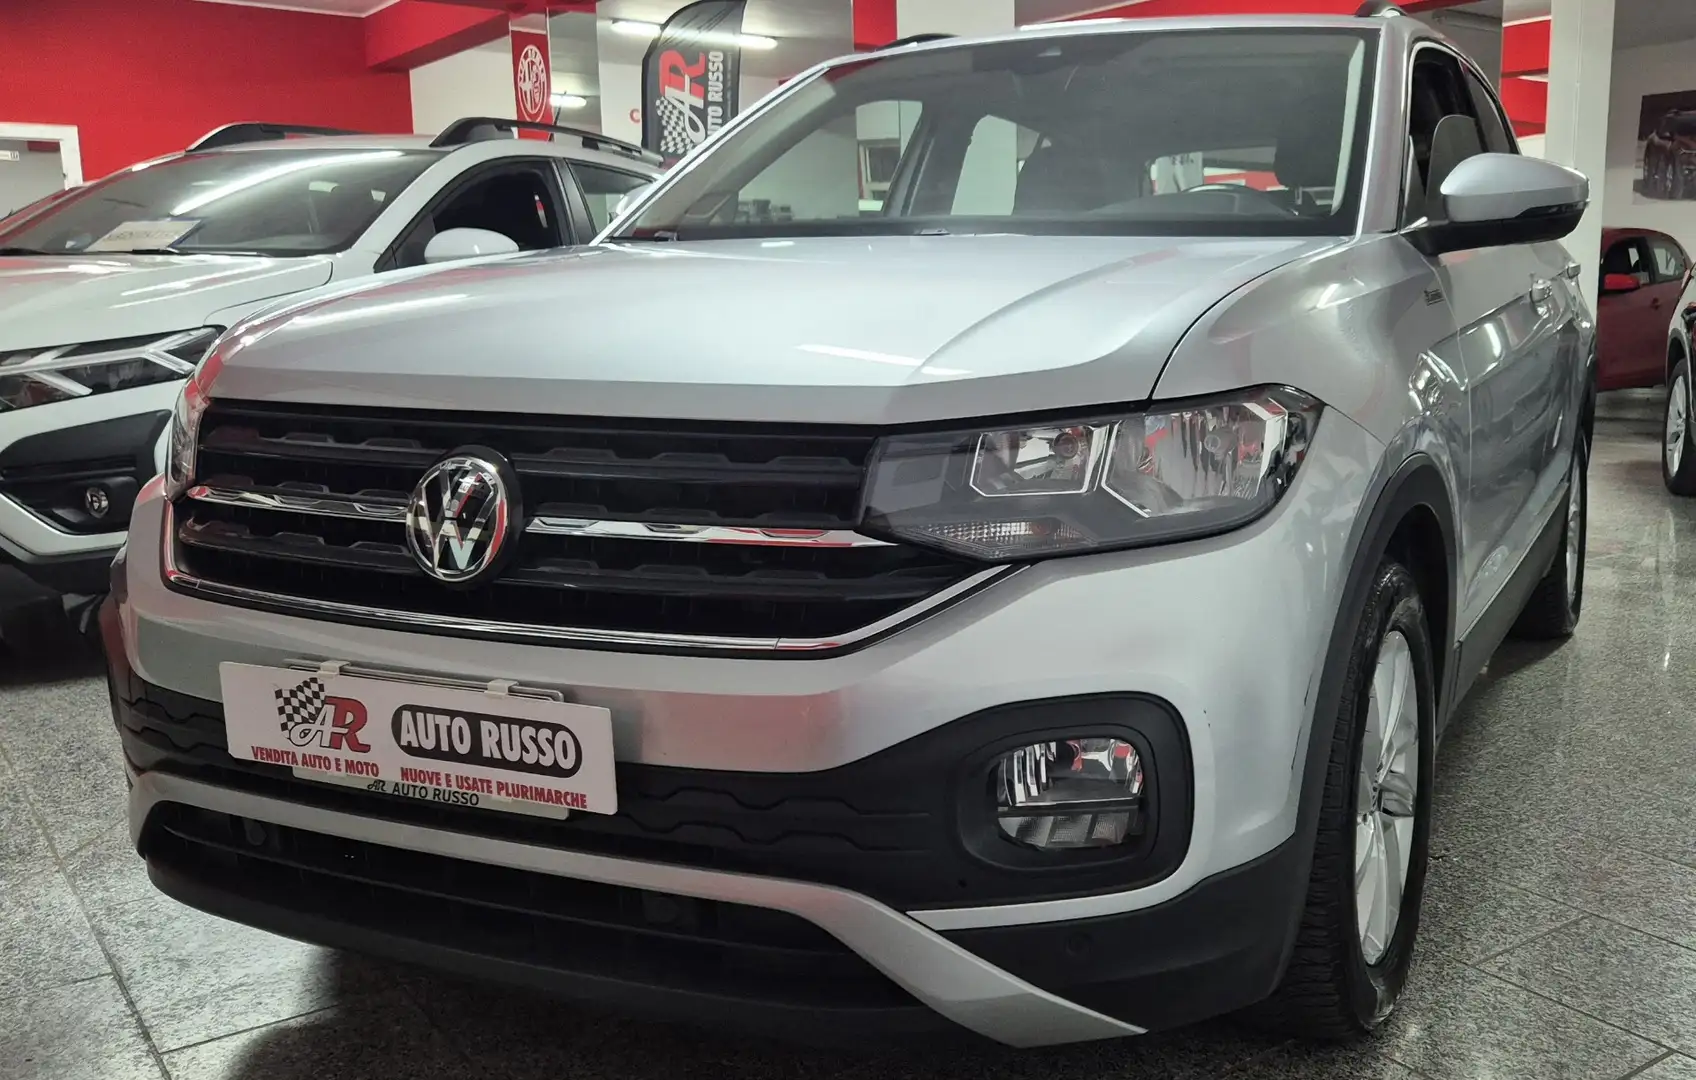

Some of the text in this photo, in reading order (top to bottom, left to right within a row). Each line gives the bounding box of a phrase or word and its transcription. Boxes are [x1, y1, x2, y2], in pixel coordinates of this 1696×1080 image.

[707, 51, 724, 137] UTO RUSSO
[400, 710, 576, 770] AUTO RUSSO
[251, 746, 380, 778] VENDITA AUTO E MOTO
[392, 782, 428, 799] AUTO
[433, 788, 479, 806] RUSSO
[400, 767, 588, 809] NUOVE E USATE PLURIMARCHE
